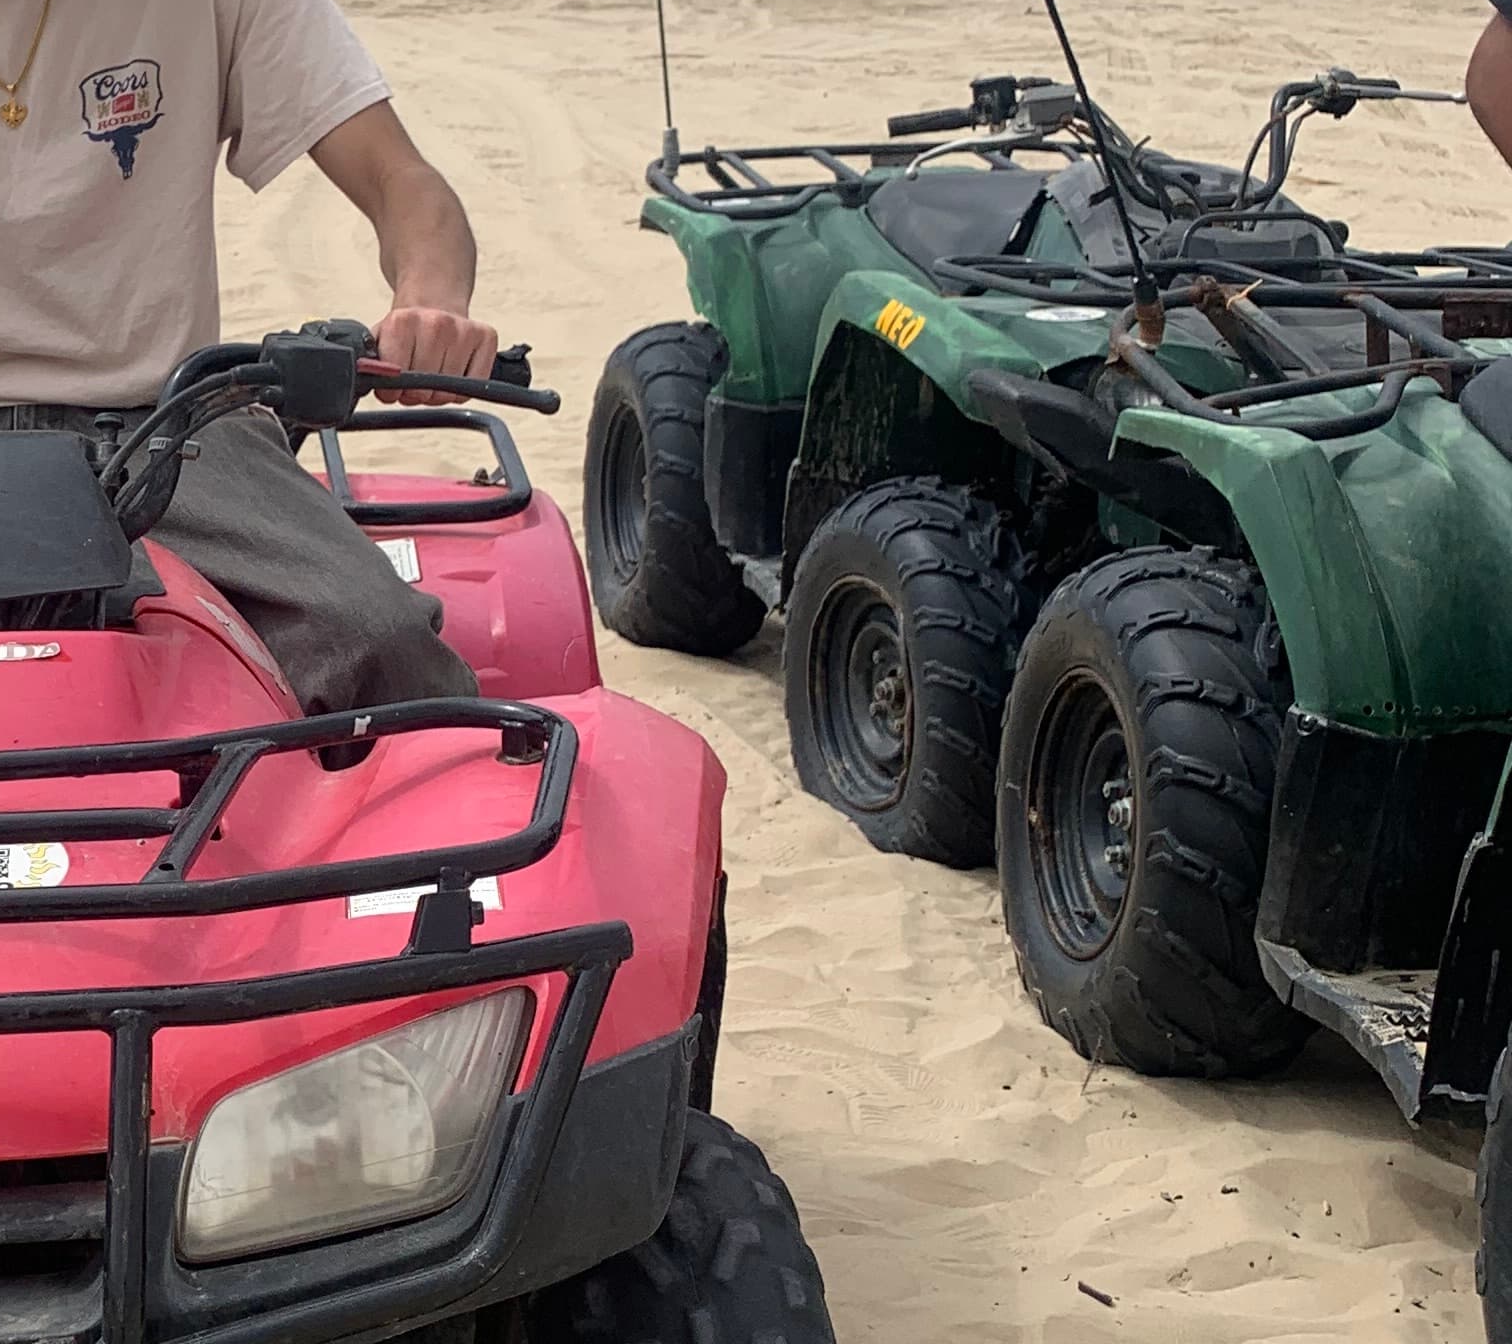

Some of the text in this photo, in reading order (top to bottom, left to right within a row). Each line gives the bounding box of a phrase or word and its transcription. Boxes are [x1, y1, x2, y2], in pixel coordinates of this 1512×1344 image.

[93, 71, 148, 100] Coors
[97, 110, 150, 130] RODEO
[875, 298, 926, 350] NEO
